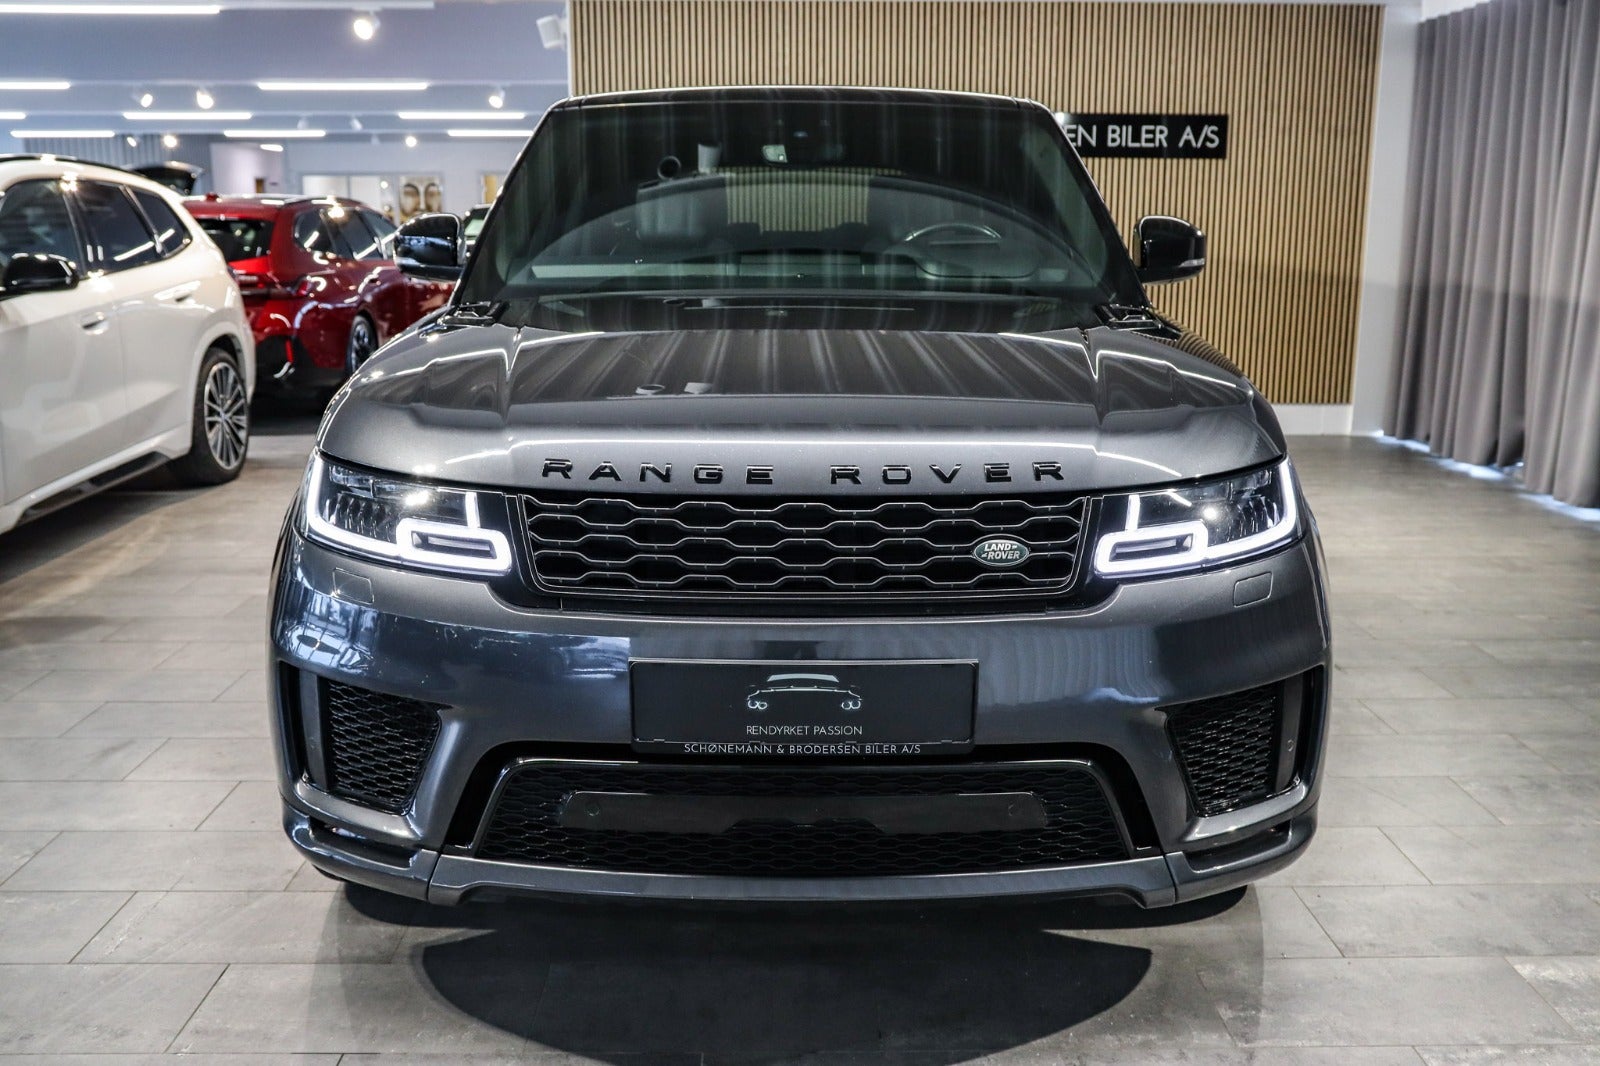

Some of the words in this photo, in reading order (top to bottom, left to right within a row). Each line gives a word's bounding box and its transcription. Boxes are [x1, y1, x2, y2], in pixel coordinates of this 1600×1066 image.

[1107, 125, 1168, 147] BILER
[1178, 125, 1220, 148] A/S
[541, 458, 774, 486] RANGE
[831, 461, 1066, 486] ROVER
[984, 543, 1012, 552] LAND
[987, 551, 1021, 560] ROVER
[746, 725, 809, 736] RENDYRKET
[813, 725, 863, 736] PASSION
[684, 744, 772, 755] SCHØNEMANN
[776, 744, 785, 755] &
[789, 744, 861, 755] BRODERSEN
[865, 744, 897, 755] BILER
[901, 744, 921, 755] A/S
